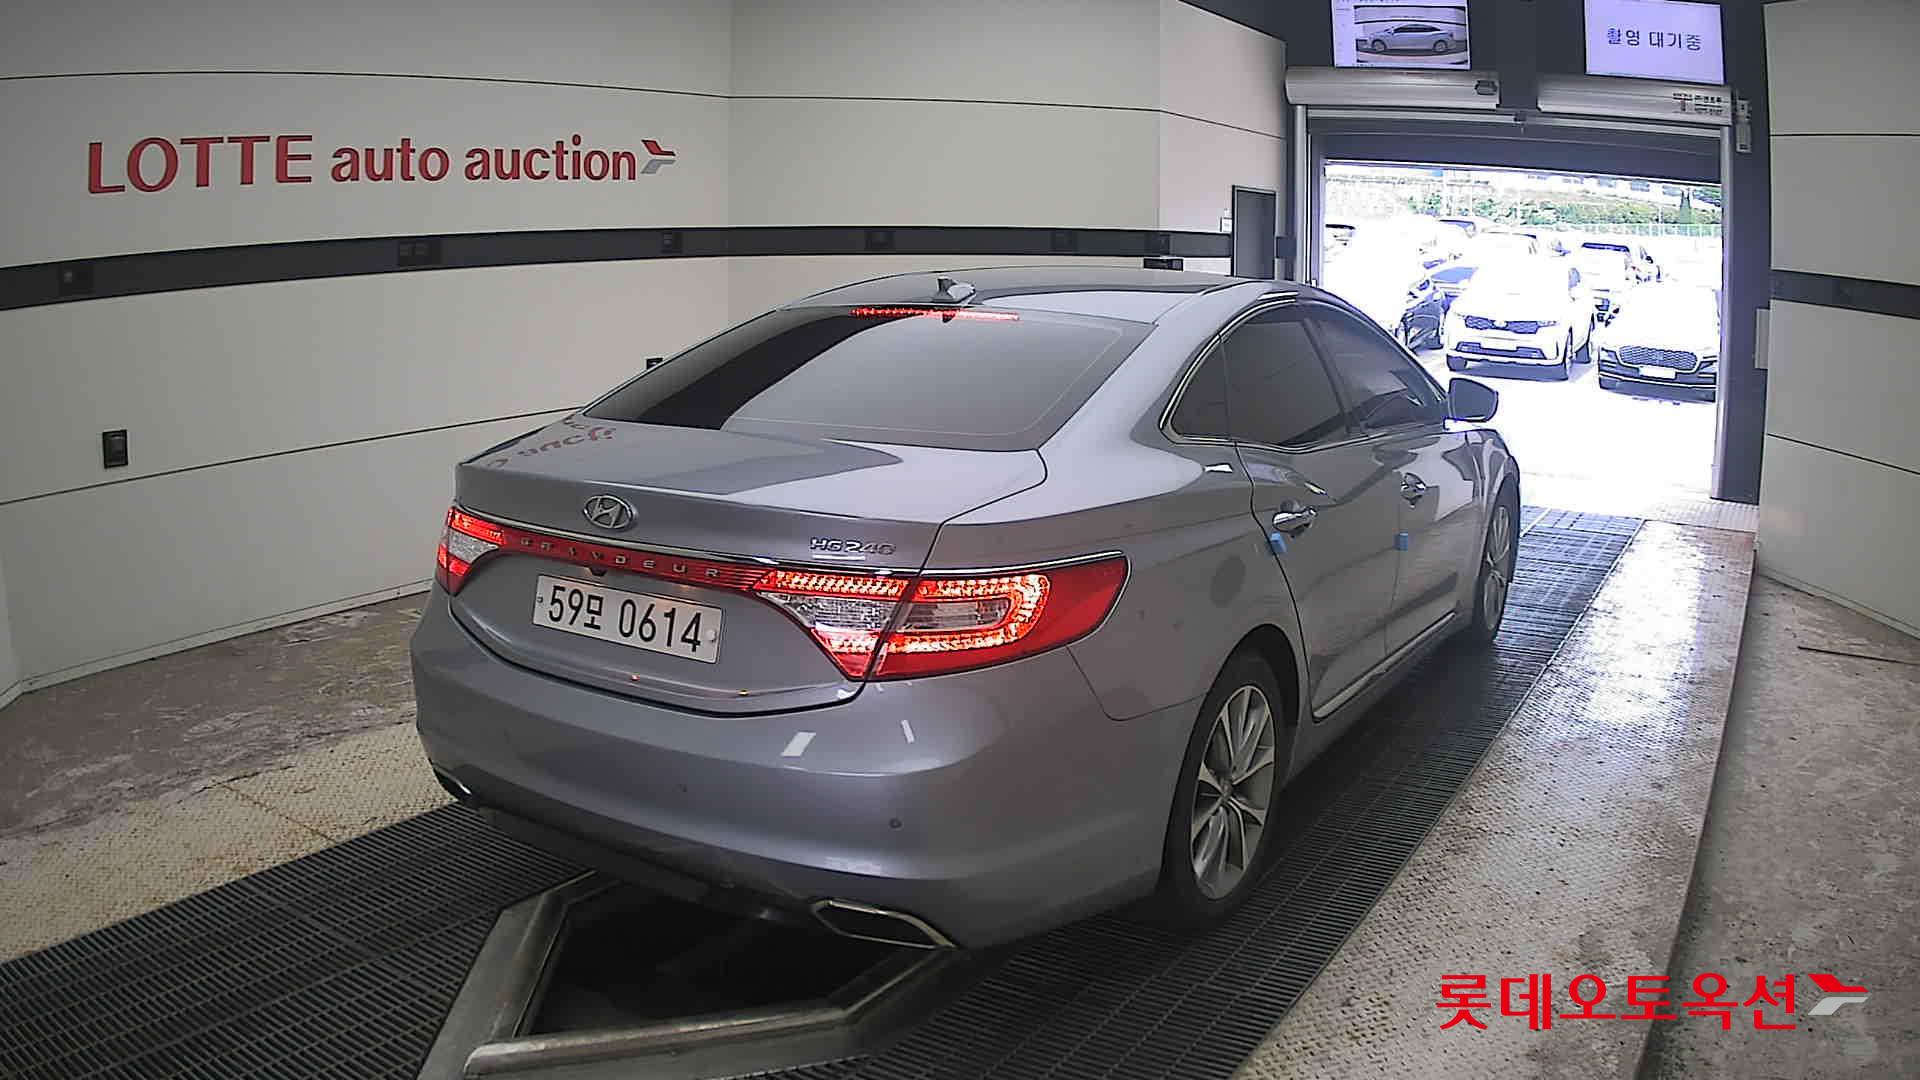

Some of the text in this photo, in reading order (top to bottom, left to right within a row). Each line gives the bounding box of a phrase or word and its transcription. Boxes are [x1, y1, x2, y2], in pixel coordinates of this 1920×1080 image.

[1648, 31, 1702, 51] 대기중
[88, 134, 637, 193] LOTTE auto auction
[520, 536, 721, 578] GRANDEUR
[810, 537, 897, 555] HG240
[548, 584, 702, 653] 59모 0614
